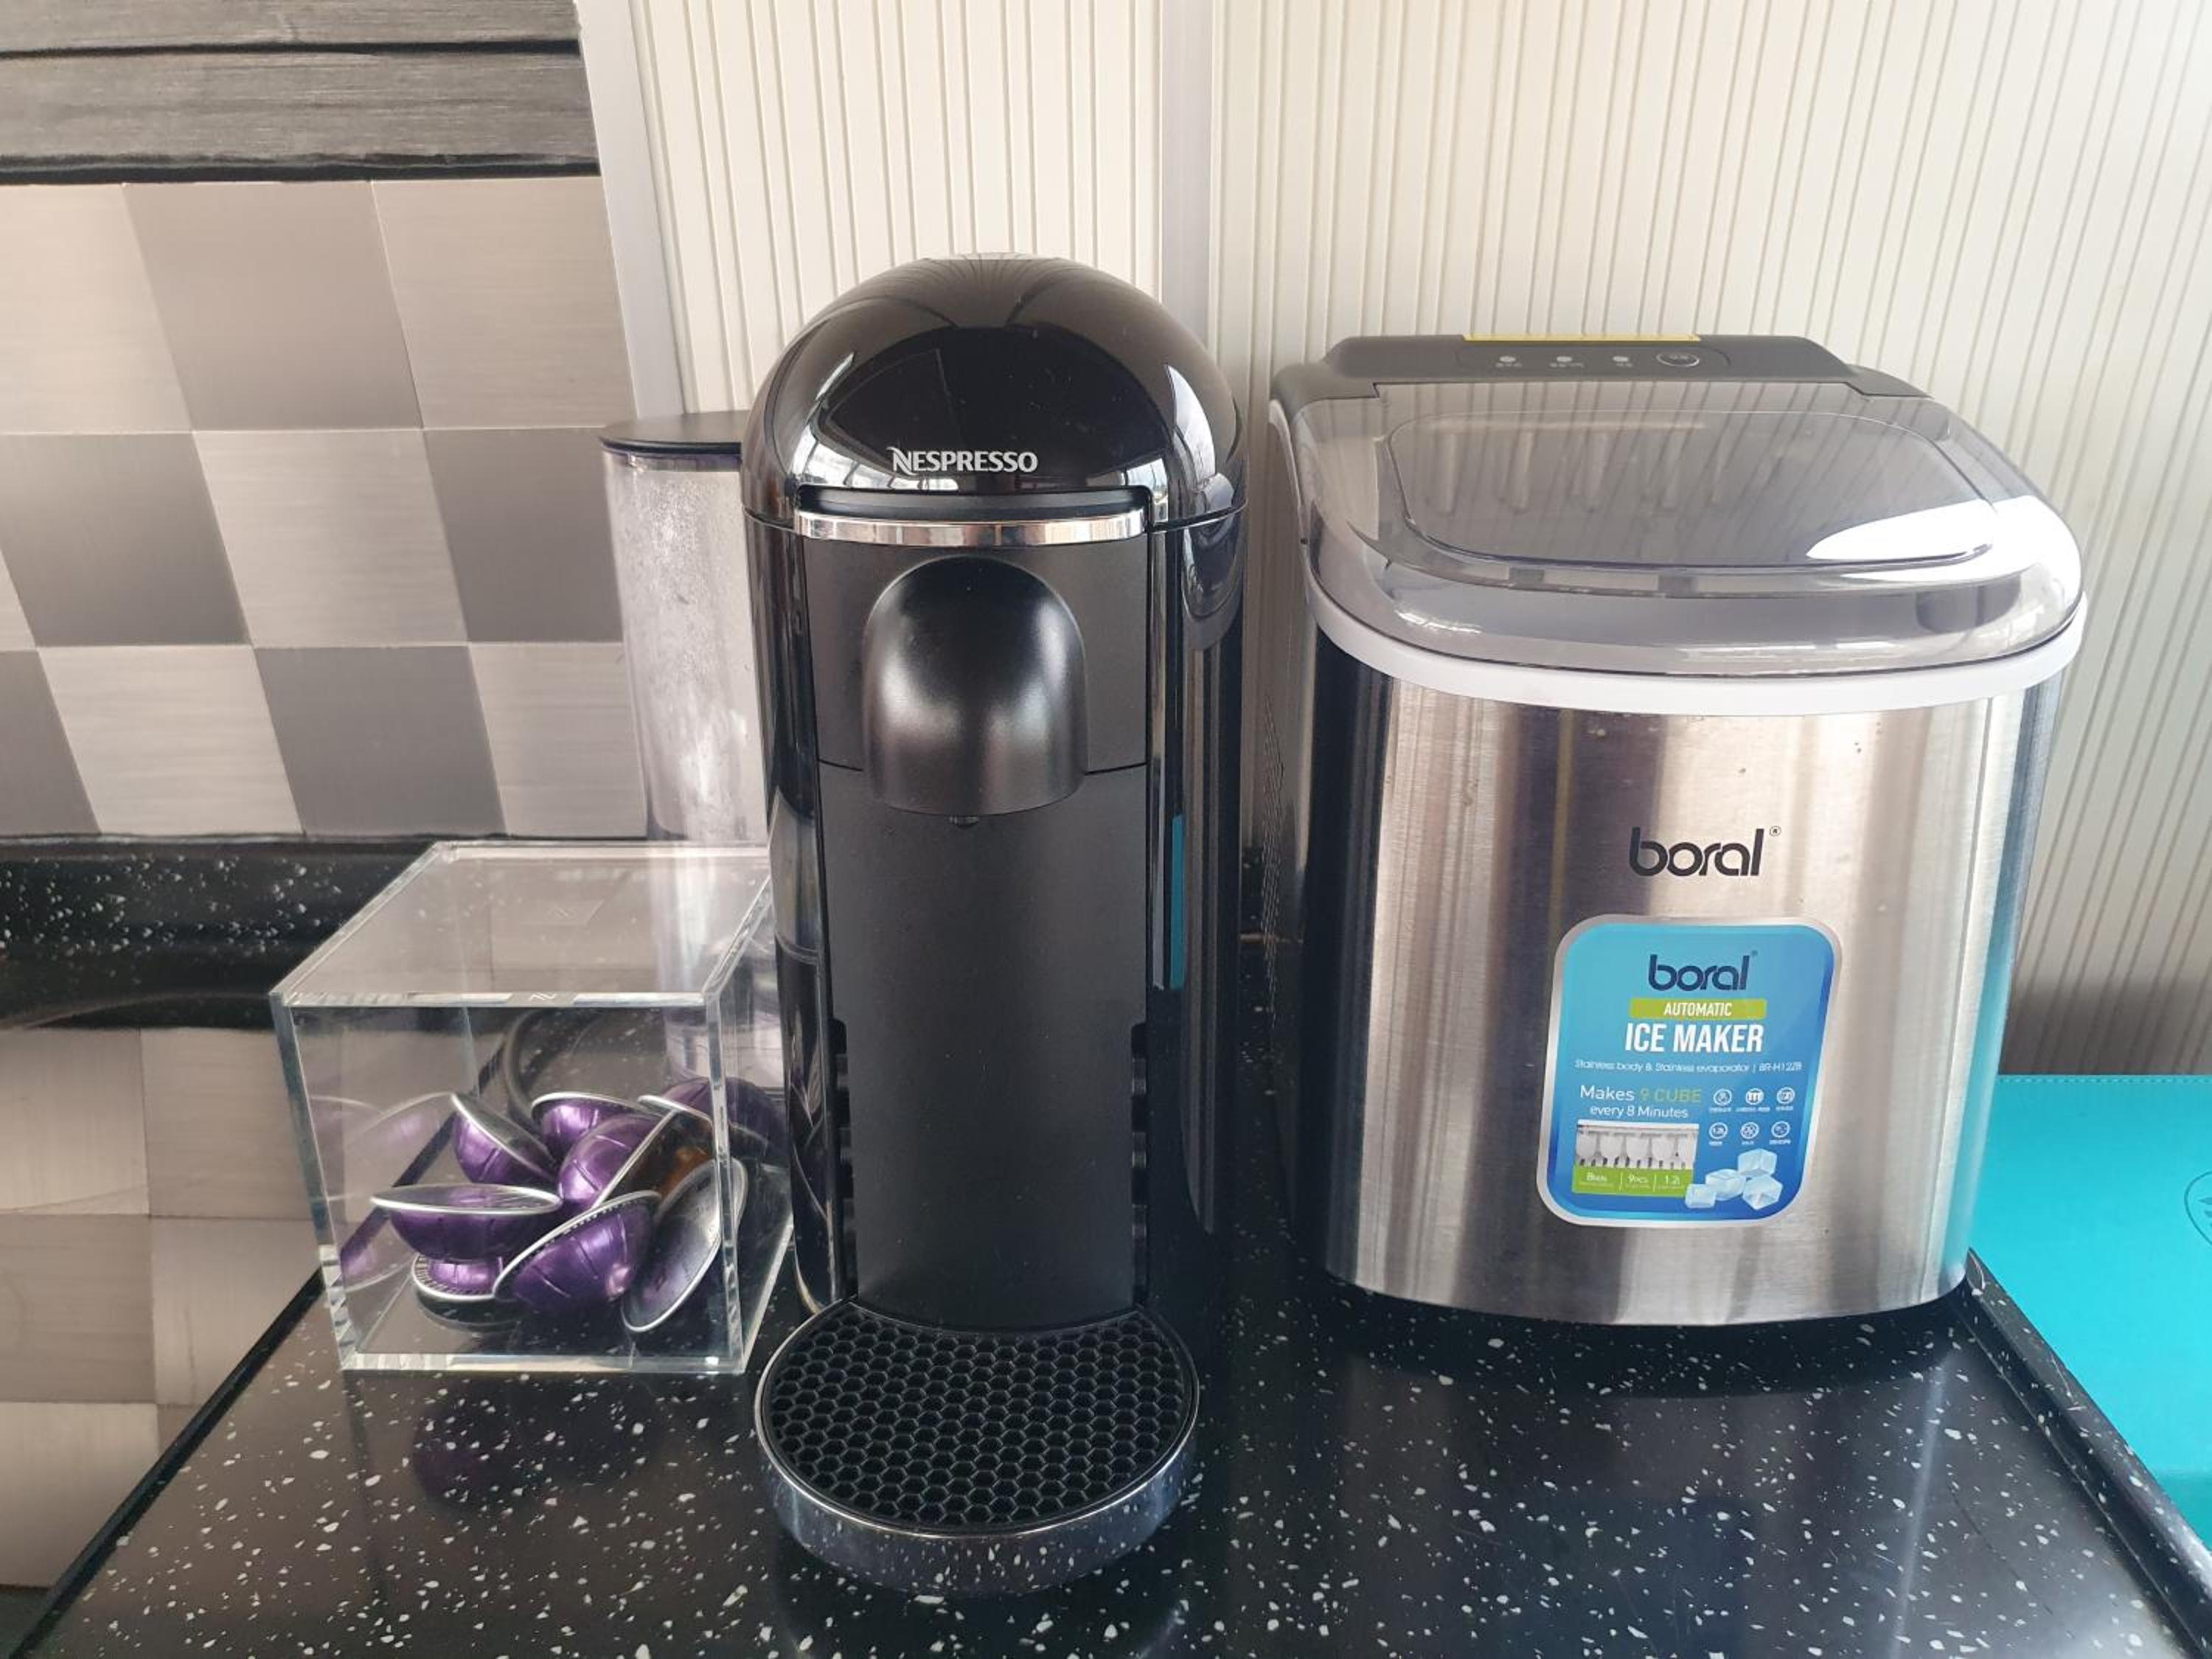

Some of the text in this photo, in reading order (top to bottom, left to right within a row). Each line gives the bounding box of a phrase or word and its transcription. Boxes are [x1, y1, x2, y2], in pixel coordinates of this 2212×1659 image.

[886, 446, 1038, 476] NESPRESSO
[1663, 1002, 1733, 1016] AUTOMATIC
[1625, 1023, 1764, 1053] ICE MAKER
[1580, 1085, 1635, 1101] Makes
[1654, 1088, 1702, 1102] CUBE
[1590, 1105, 1688, 1119] every 8 Minutes
